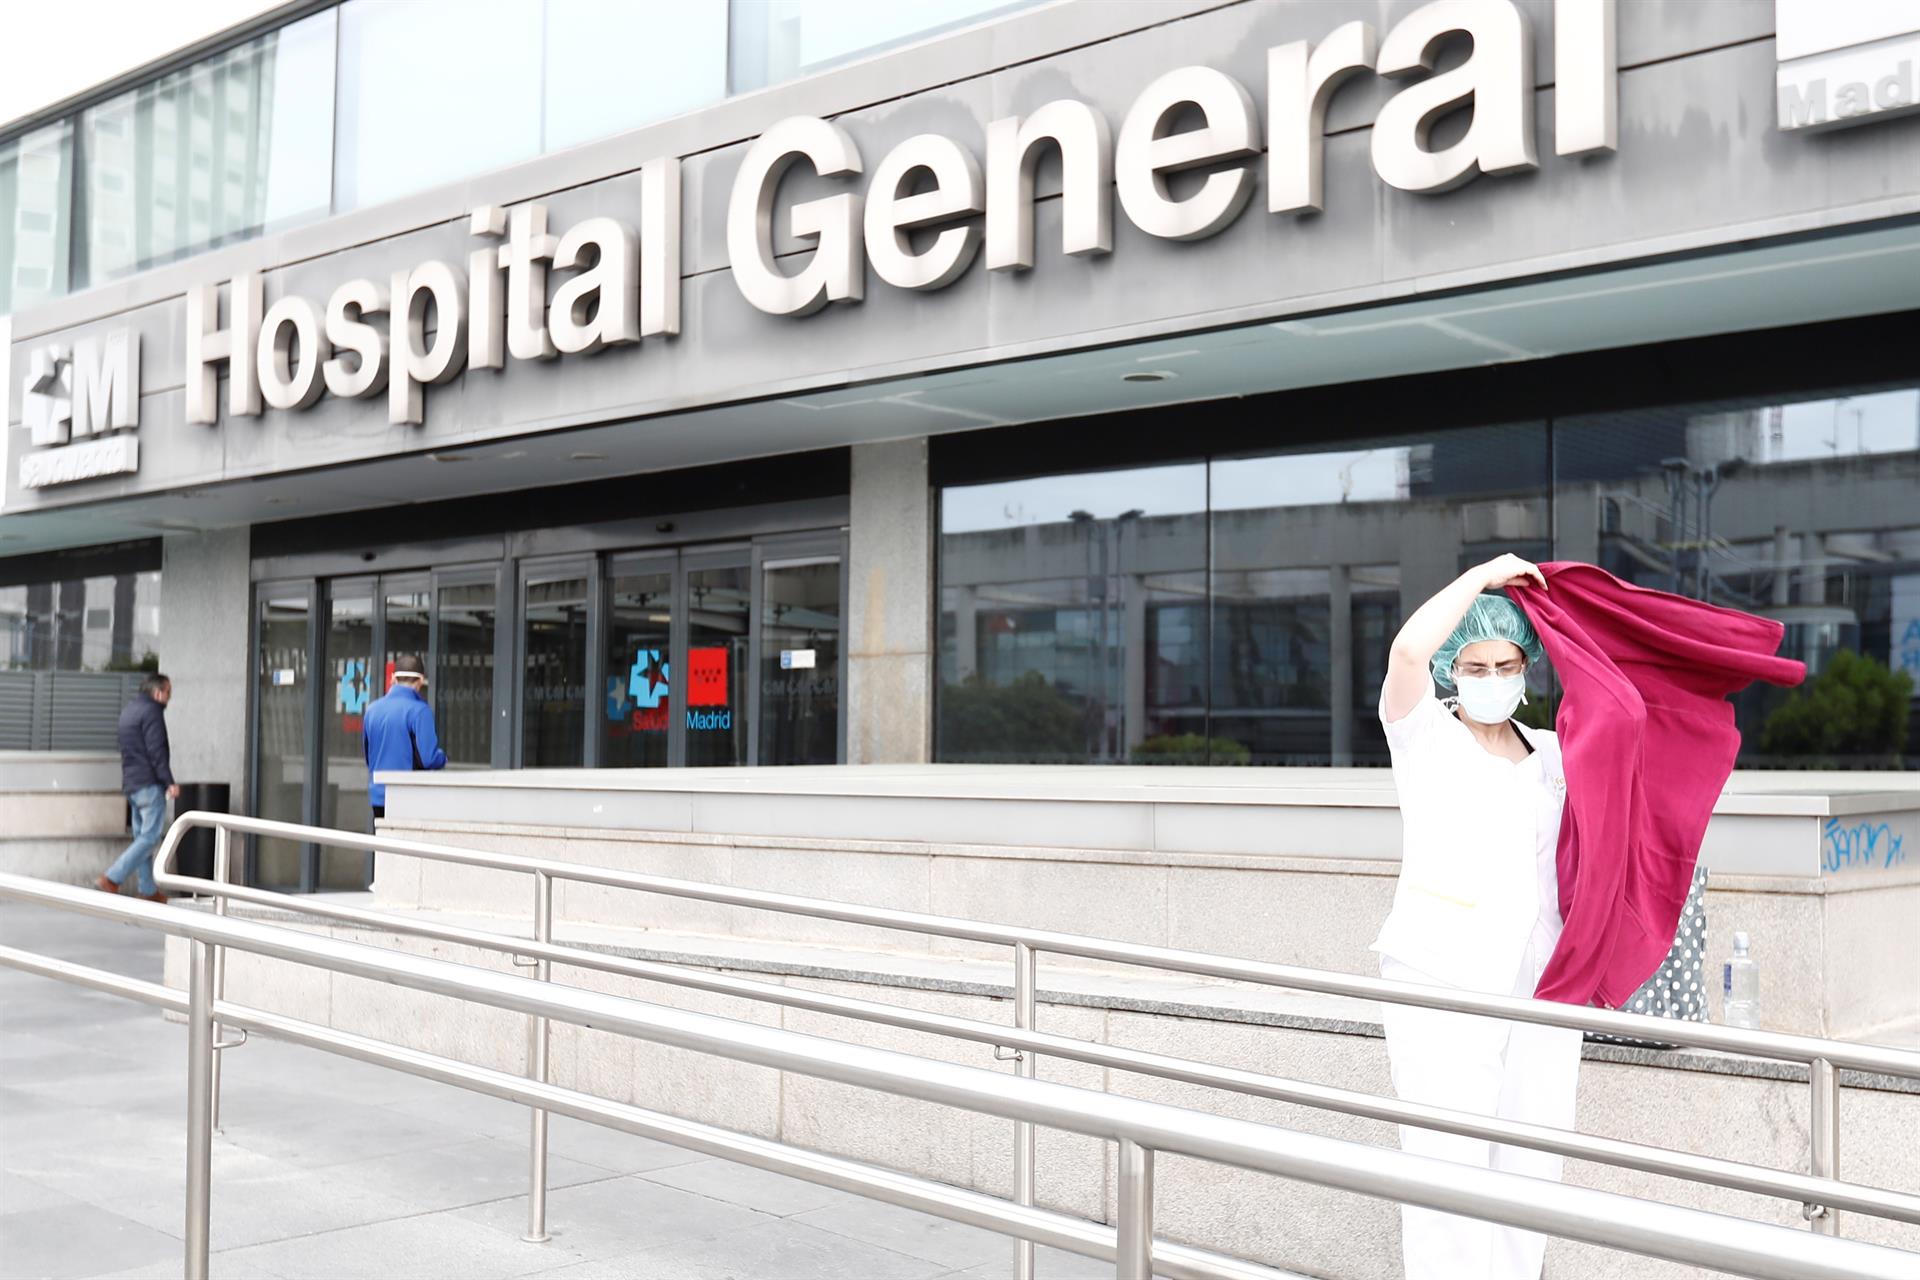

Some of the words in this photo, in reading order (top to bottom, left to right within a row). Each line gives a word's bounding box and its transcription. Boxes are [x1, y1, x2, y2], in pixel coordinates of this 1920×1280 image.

[1780, 58, 1920, 129] Mad
[186, 157, 682, 424] Hospital
[727, 0, 1616, 316] General
[686, 711, 731, 729] Madrid
